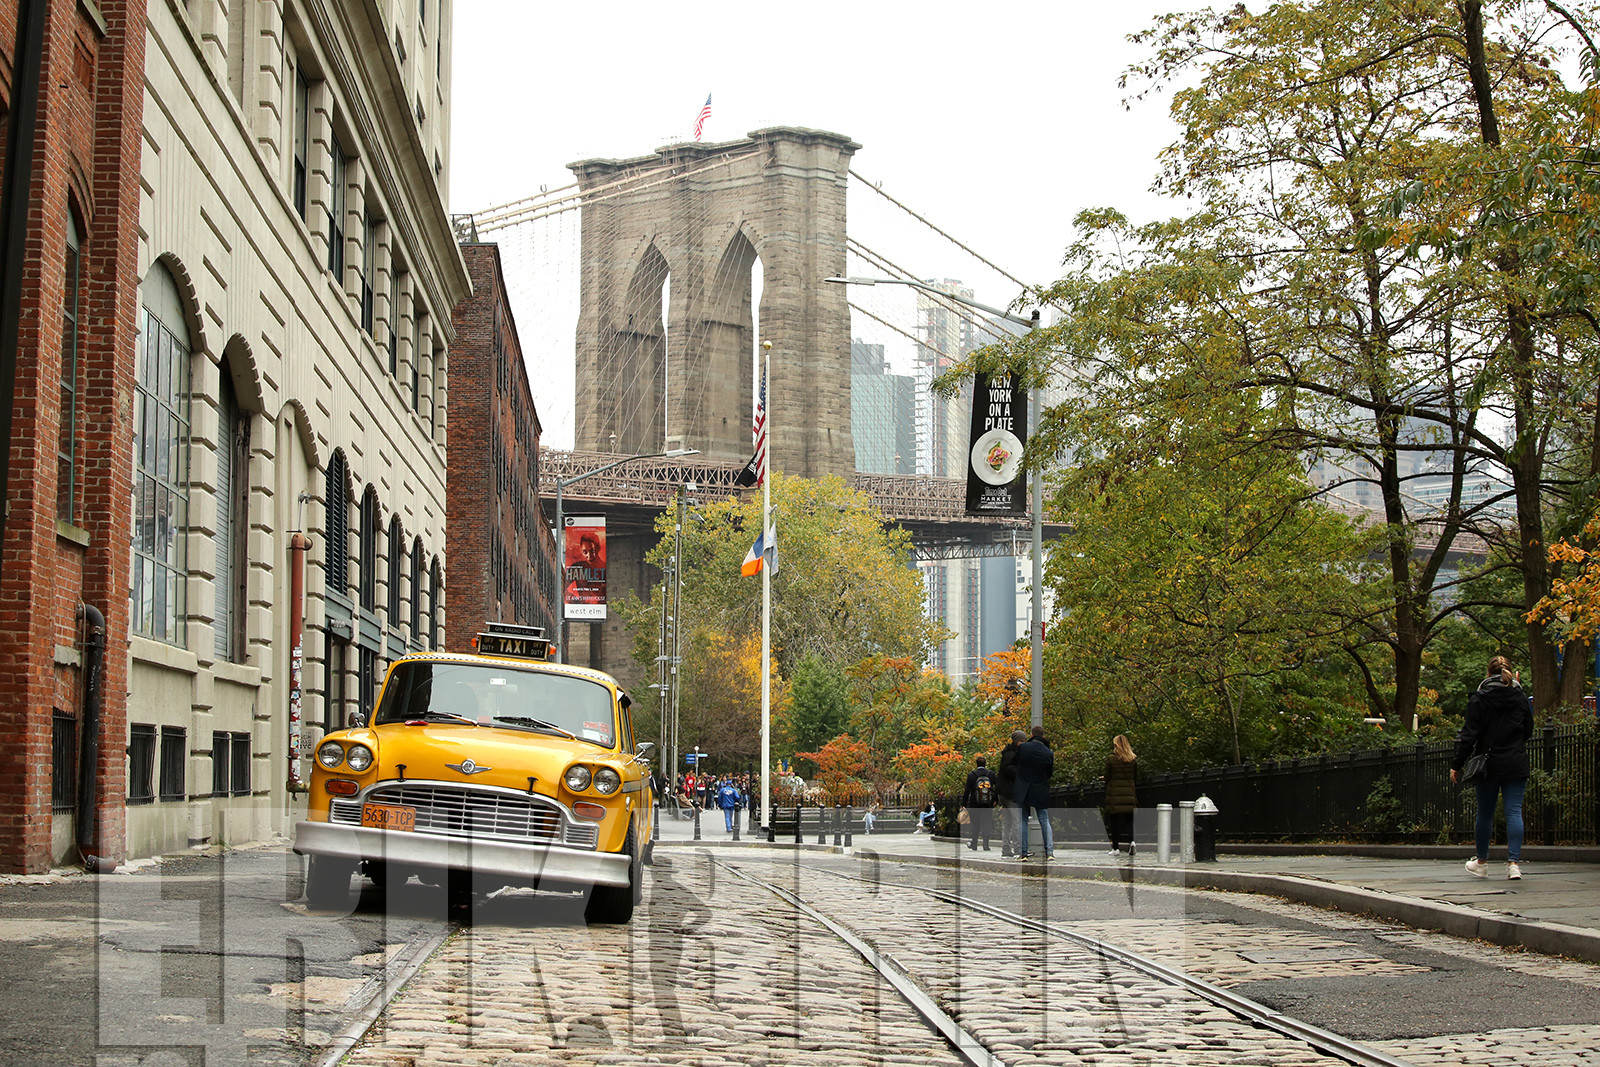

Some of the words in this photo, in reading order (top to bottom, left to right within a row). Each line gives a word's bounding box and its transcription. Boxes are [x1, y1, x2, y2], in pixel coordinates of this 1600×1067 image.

[989, 389, 1012, 402] YORK
[989, 403, 1001, 416] ON
[1004, 403, 1010, 416] A
[985, 418, 1013, 430] PLATE
[566, 568, 605, 580] HAMLET
[499, 639, 526, 654] TAXI
[365, 807, 413, 825] 5630-TCP
